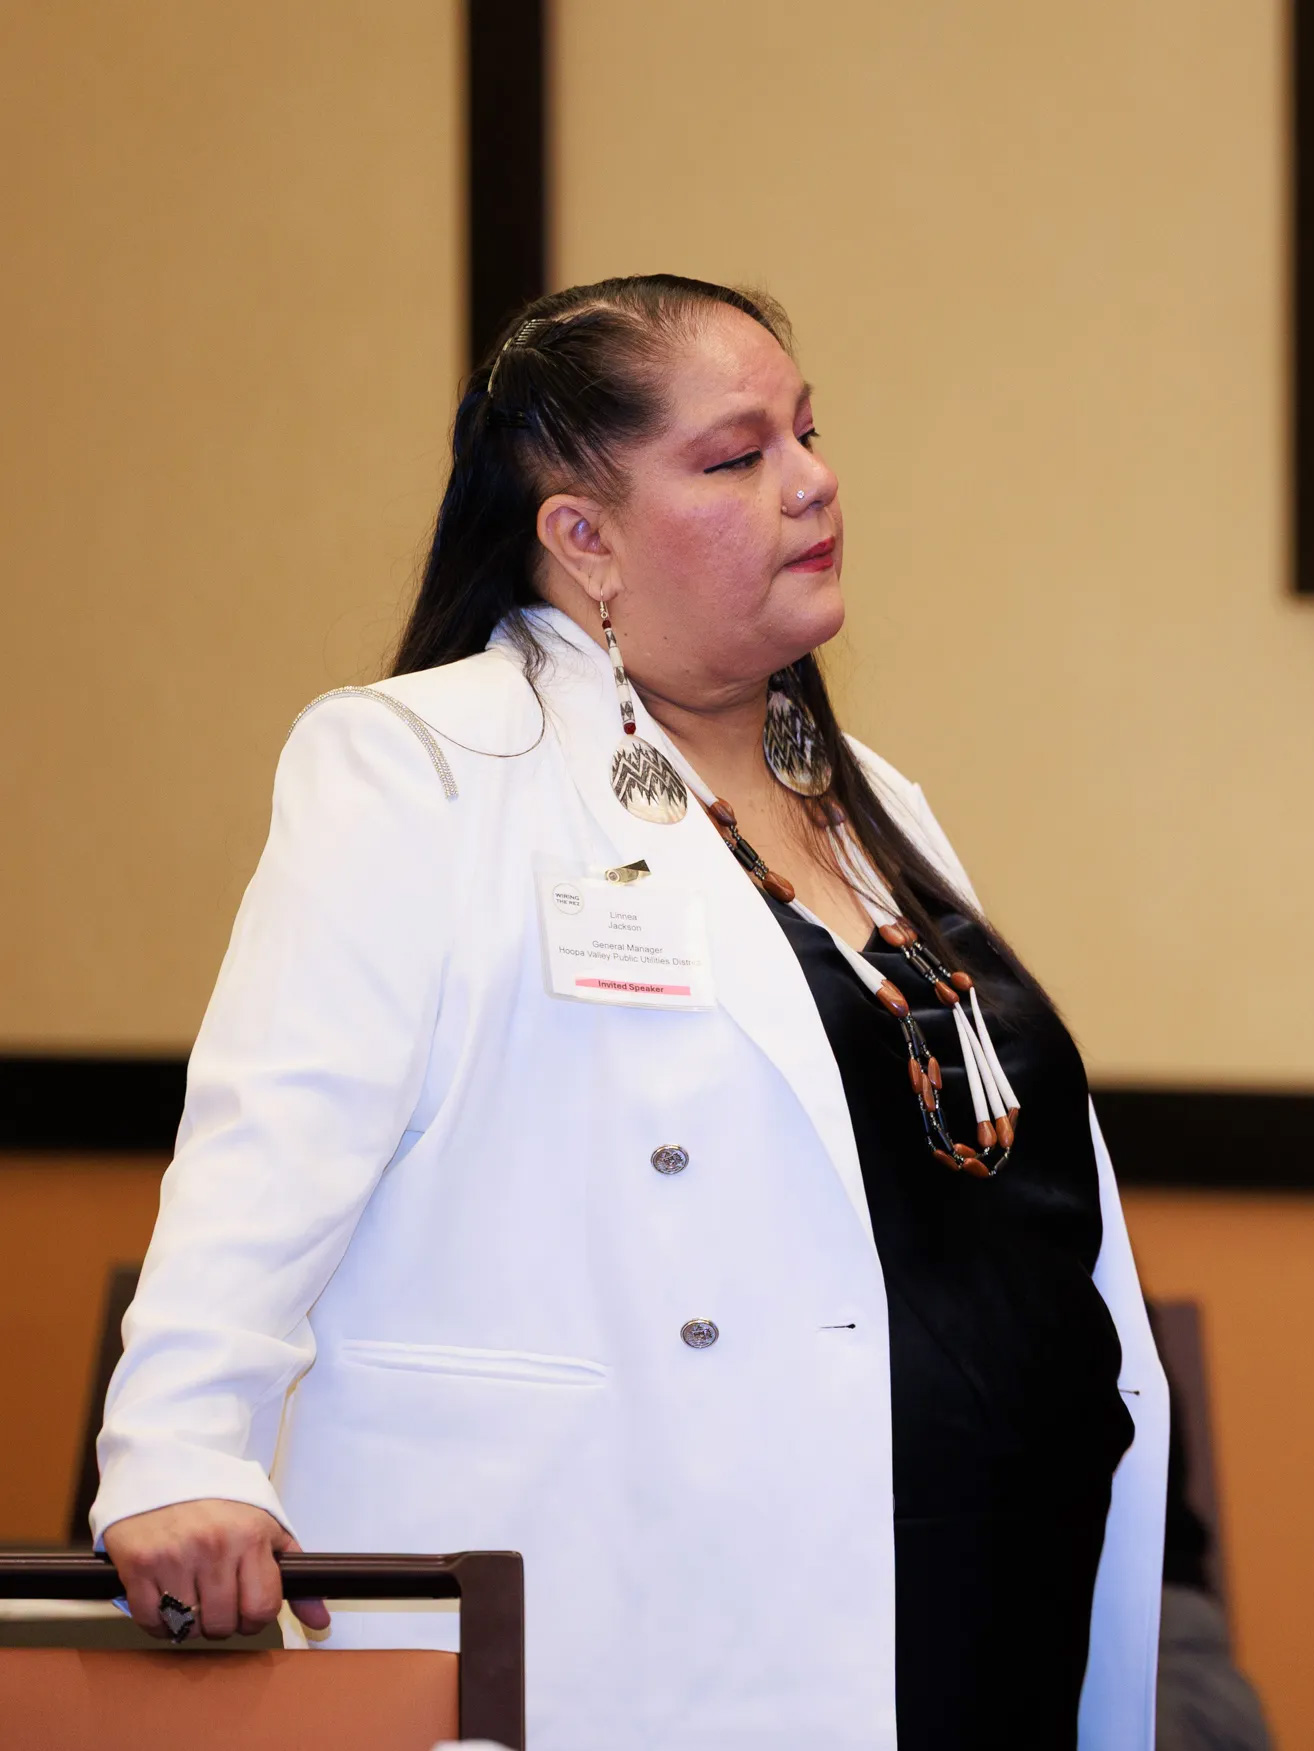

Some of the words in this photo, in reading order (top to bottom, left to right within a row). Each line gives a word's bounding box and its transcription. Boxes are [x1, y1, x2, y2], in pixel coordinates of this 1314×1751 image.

[610, 911, 638, 921] Linnea
[608, 922, 642, 932] Jackson
[592, 940, 625, 951] General
[627, 944, 663, 955] Manager
[559, 946, 585, 957] Hoopa
[587, 950, 611, 961] Valley
[613, 953, 638, 963] Public
[640, 955, 670, 965] Utilities
[598, 980, 627, 991] Invited
[629, 982, 664, 994] Speaker
